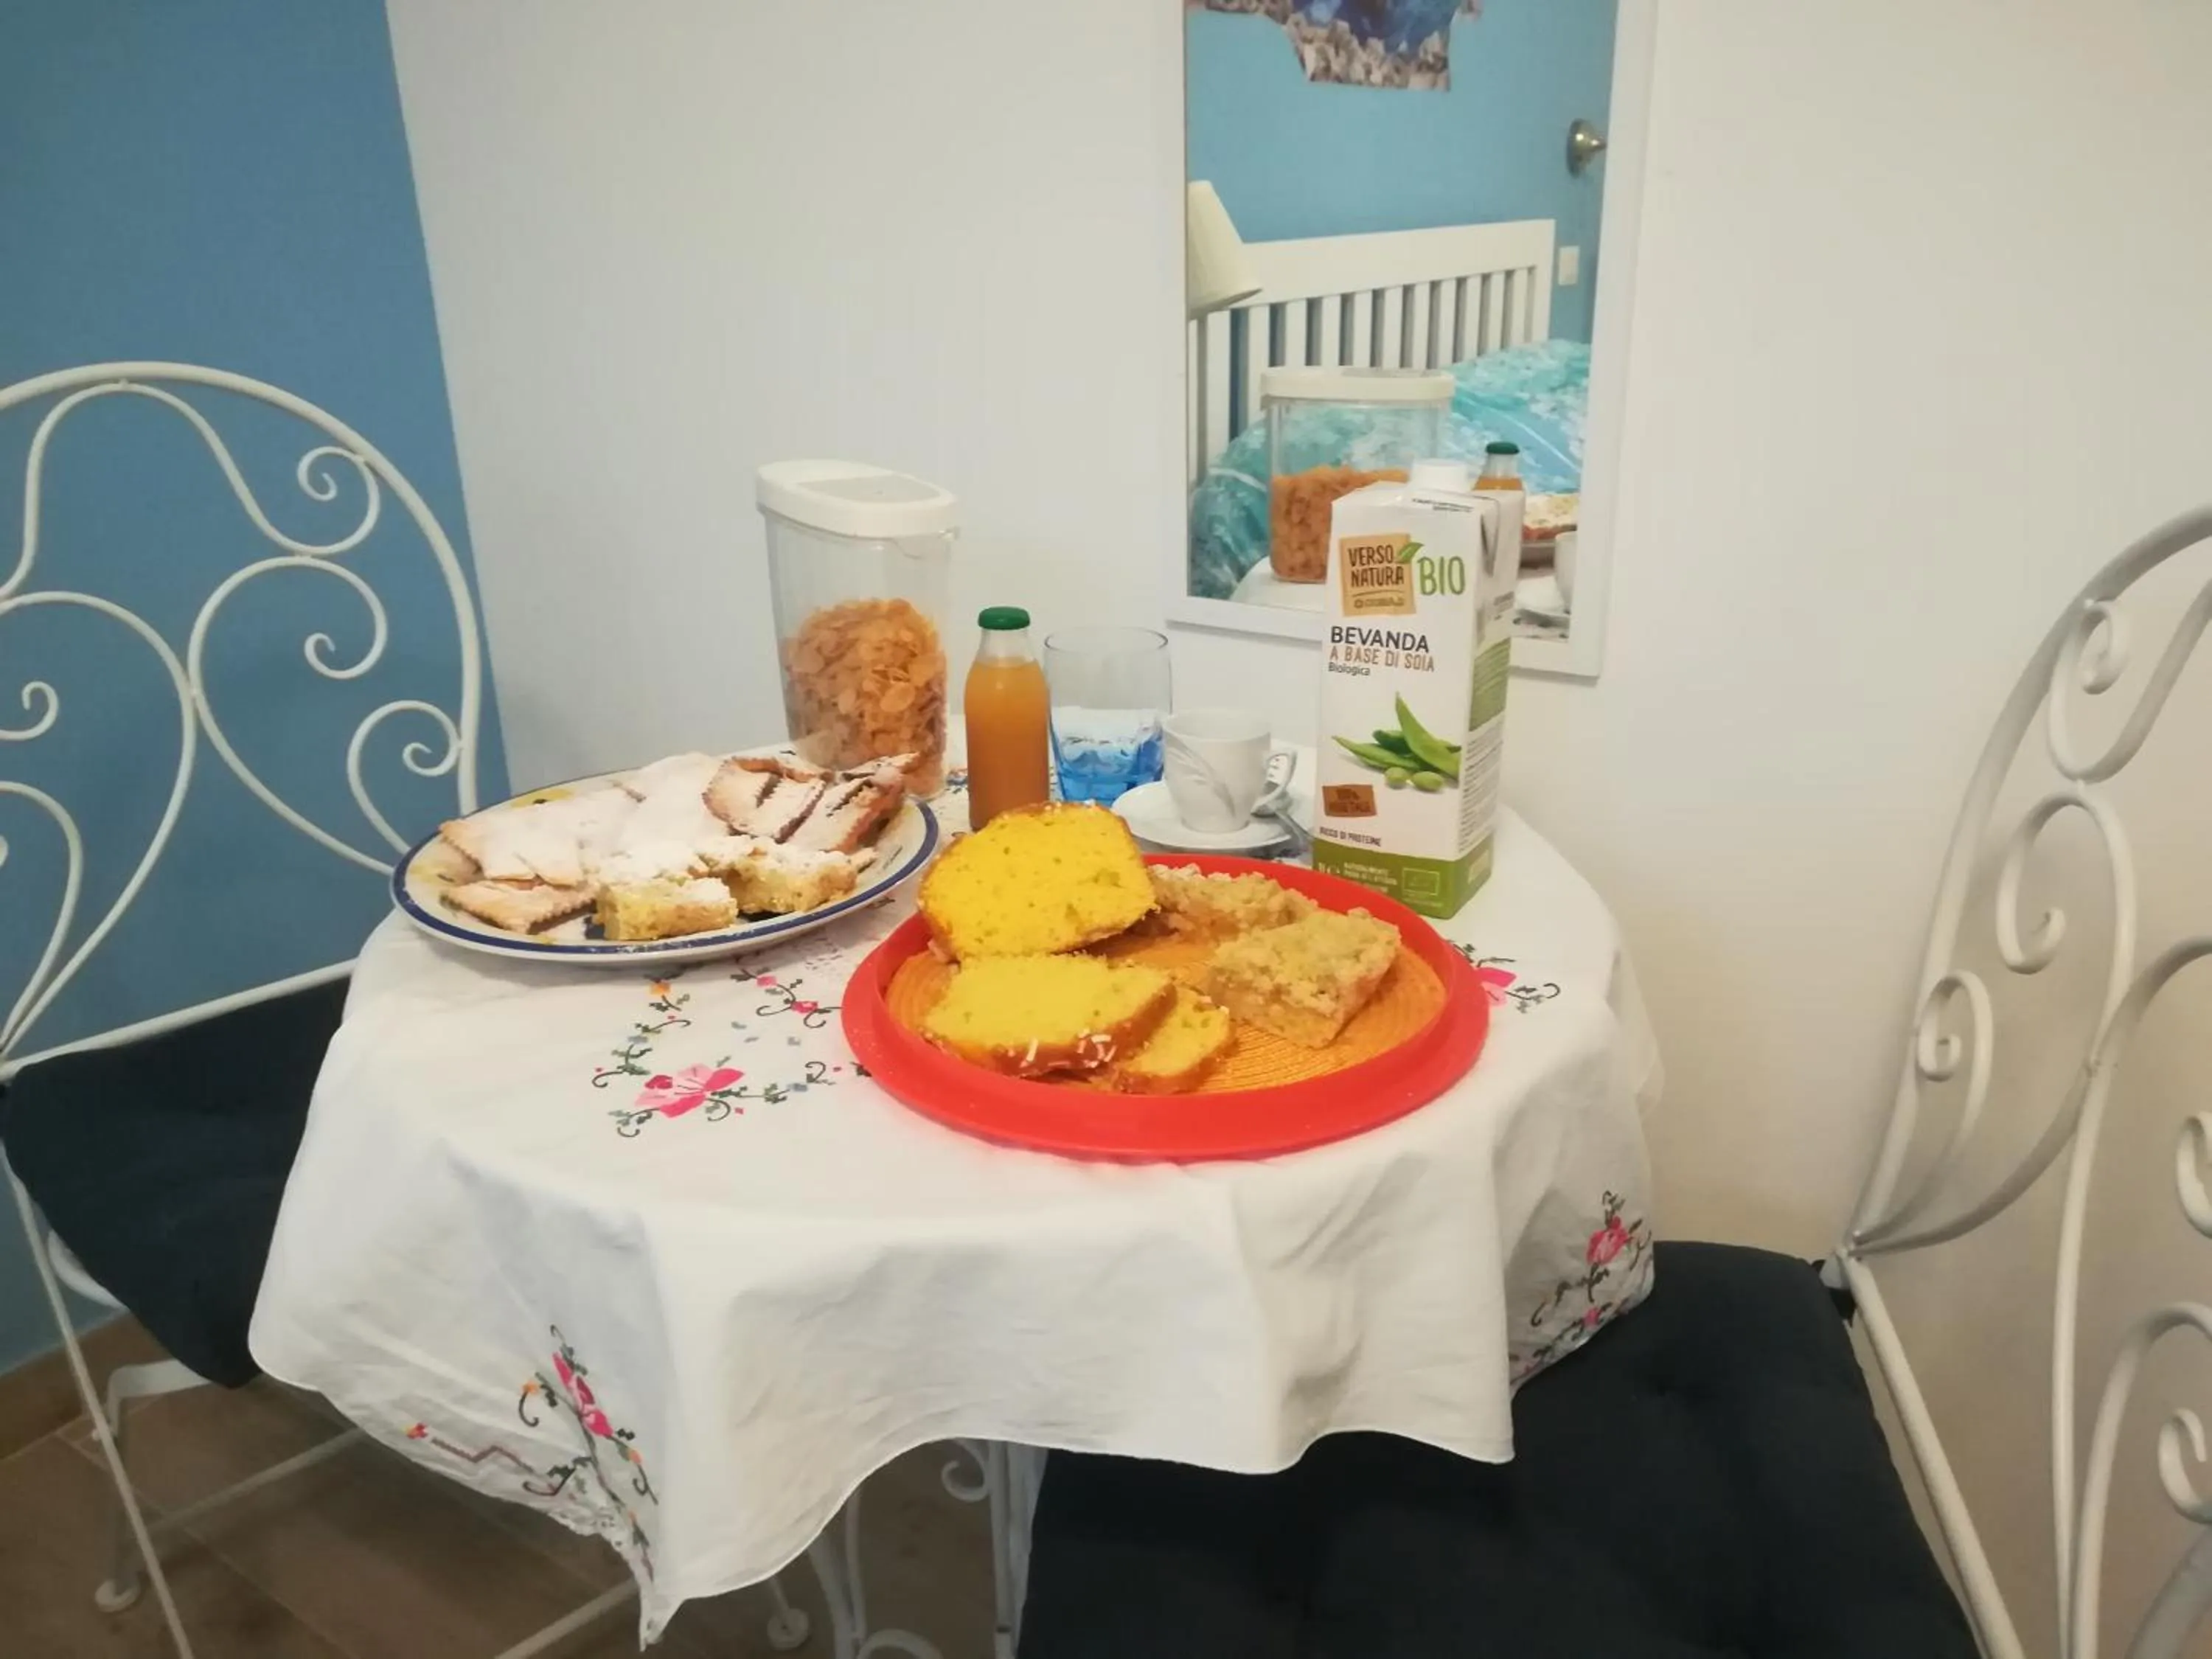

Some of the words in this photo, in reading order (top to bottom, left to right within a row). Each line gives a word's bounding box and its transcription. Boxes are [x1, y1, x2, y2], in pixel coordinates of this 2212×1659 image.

[1348, 544, 1394, 566] VERSO
[1350, 565, 1405, 588] NATURA
[1416, 555, 1467, 597] BIO
[1330, 626, 1430, 653] BEVANDA
[1328, 662, 1371, 676] Biologica
[1329, 646, 1339, 661] A
[1343, 646, 1381, 665] BASE
[1385, 650, 1399, 669] DI
[1404, 653, 1435, 672] SOIA
